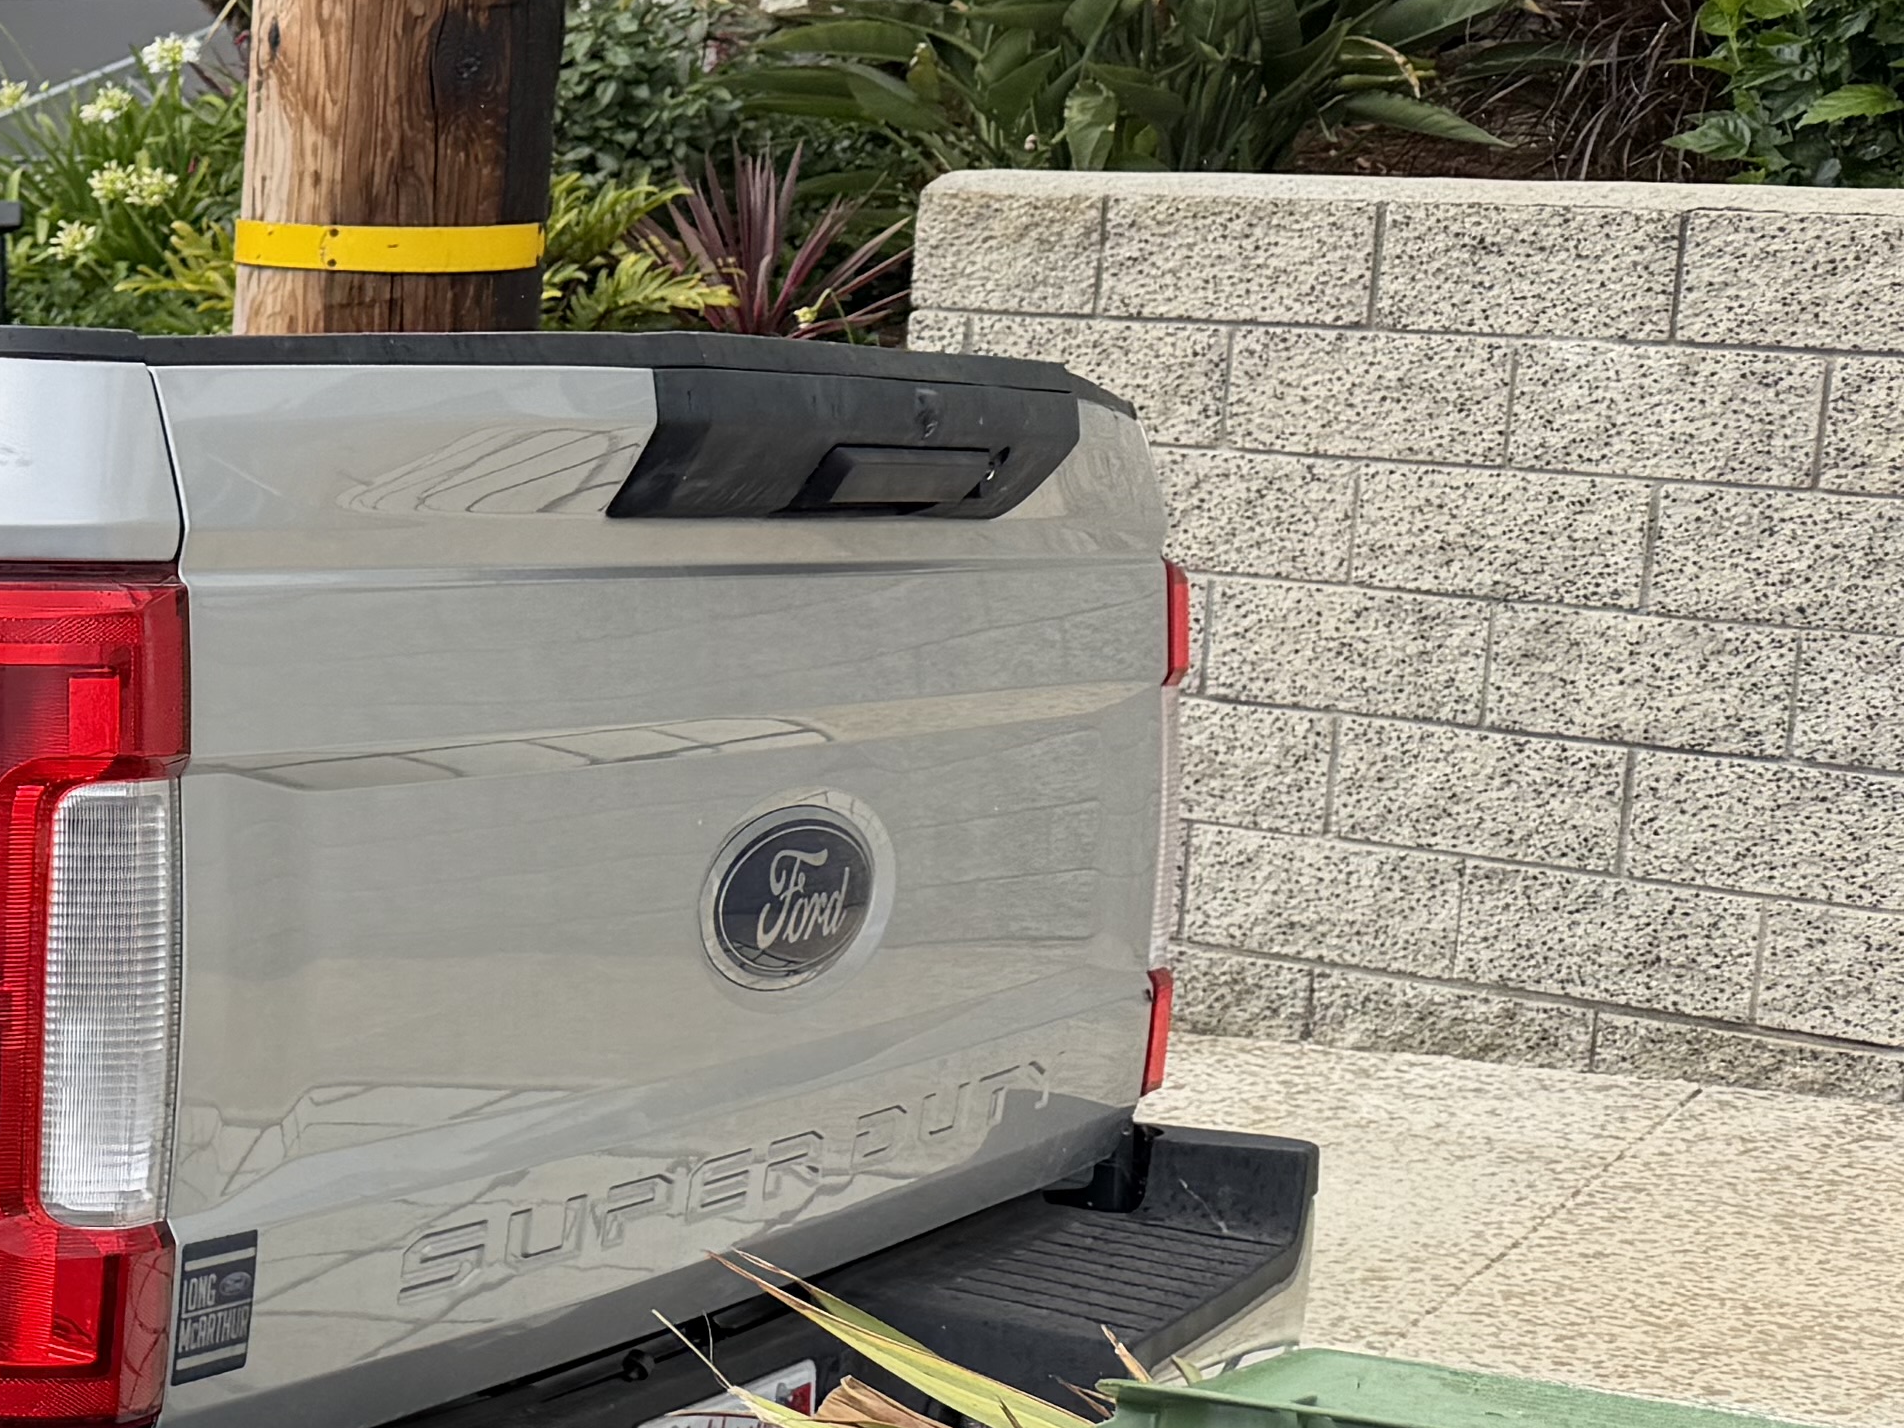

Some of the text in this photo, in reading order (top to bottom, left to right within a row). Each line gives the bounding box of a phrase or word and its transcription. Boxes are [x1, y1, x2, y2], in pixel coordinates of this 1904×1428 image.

[756, 846, 851, 951] Ford
[396, 1058, 1054, 1306] SUPER DUTY
[181, 1273, 217, 1319] LONG
